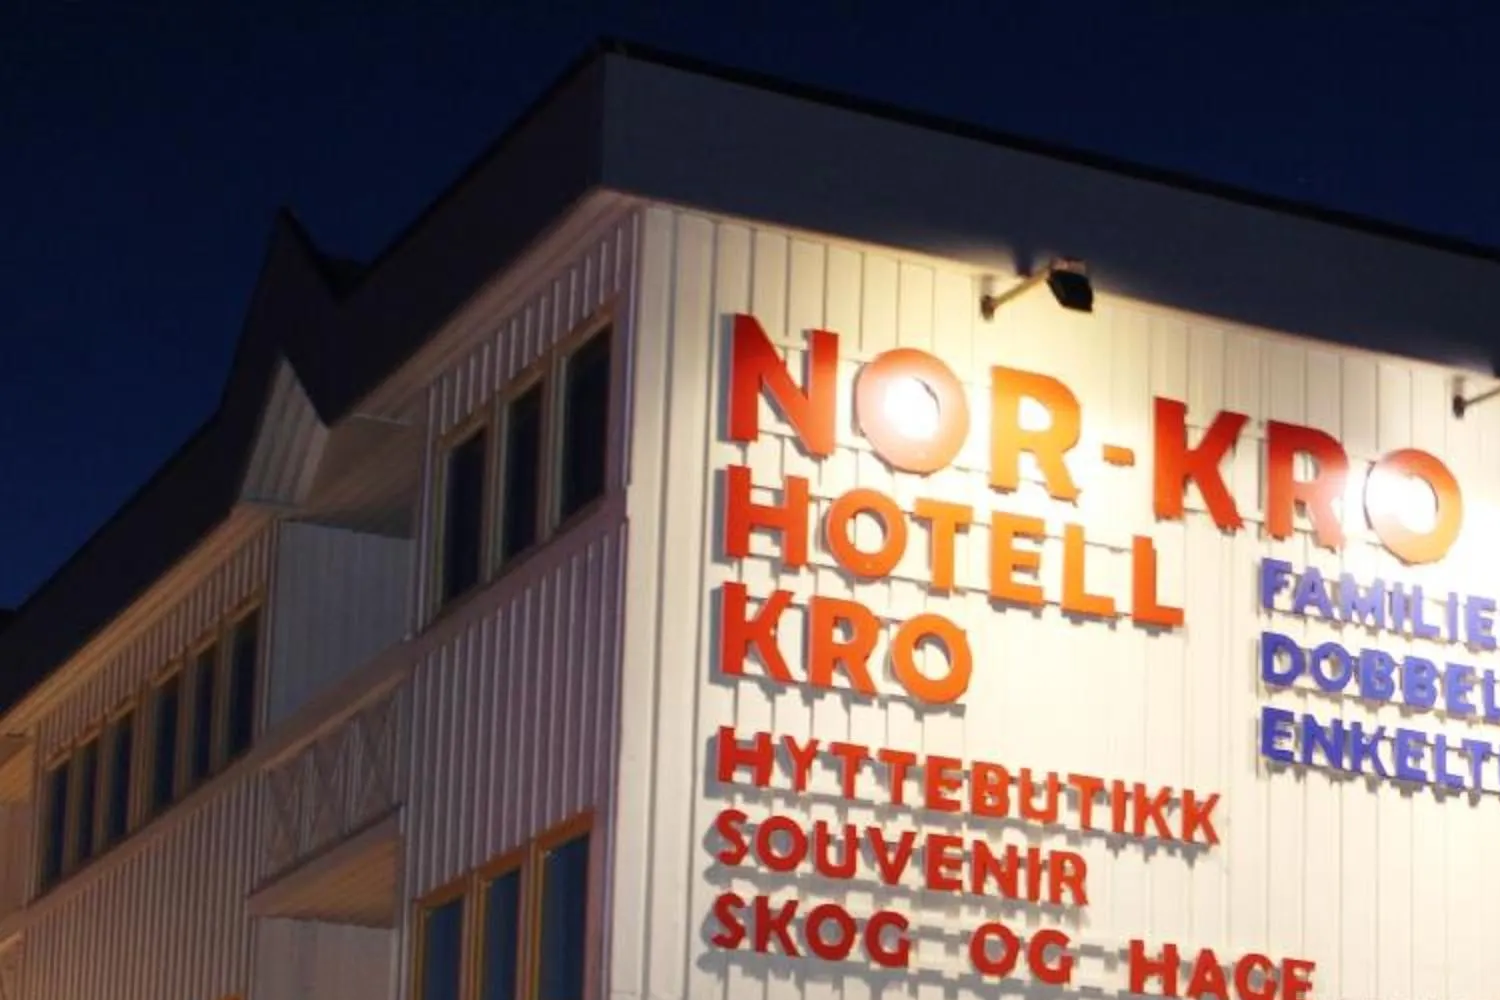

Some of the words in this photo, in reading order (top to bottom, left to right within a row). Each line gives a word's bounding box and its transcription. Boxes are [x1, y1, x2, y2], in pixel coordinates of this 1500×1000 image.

[729, 313, 1465, 566] NOR-KRO
[723, 464, 1184, 627] HOTELL
[719, 580, 973, 705] KRO
[715, 725, 1221, 846] HYTTEBUTIKK
[713, 808, 1090, 906] SOUVENIR
[710, 892, 911, 968] SKOG
[969, 922, 1074, 985] OG
